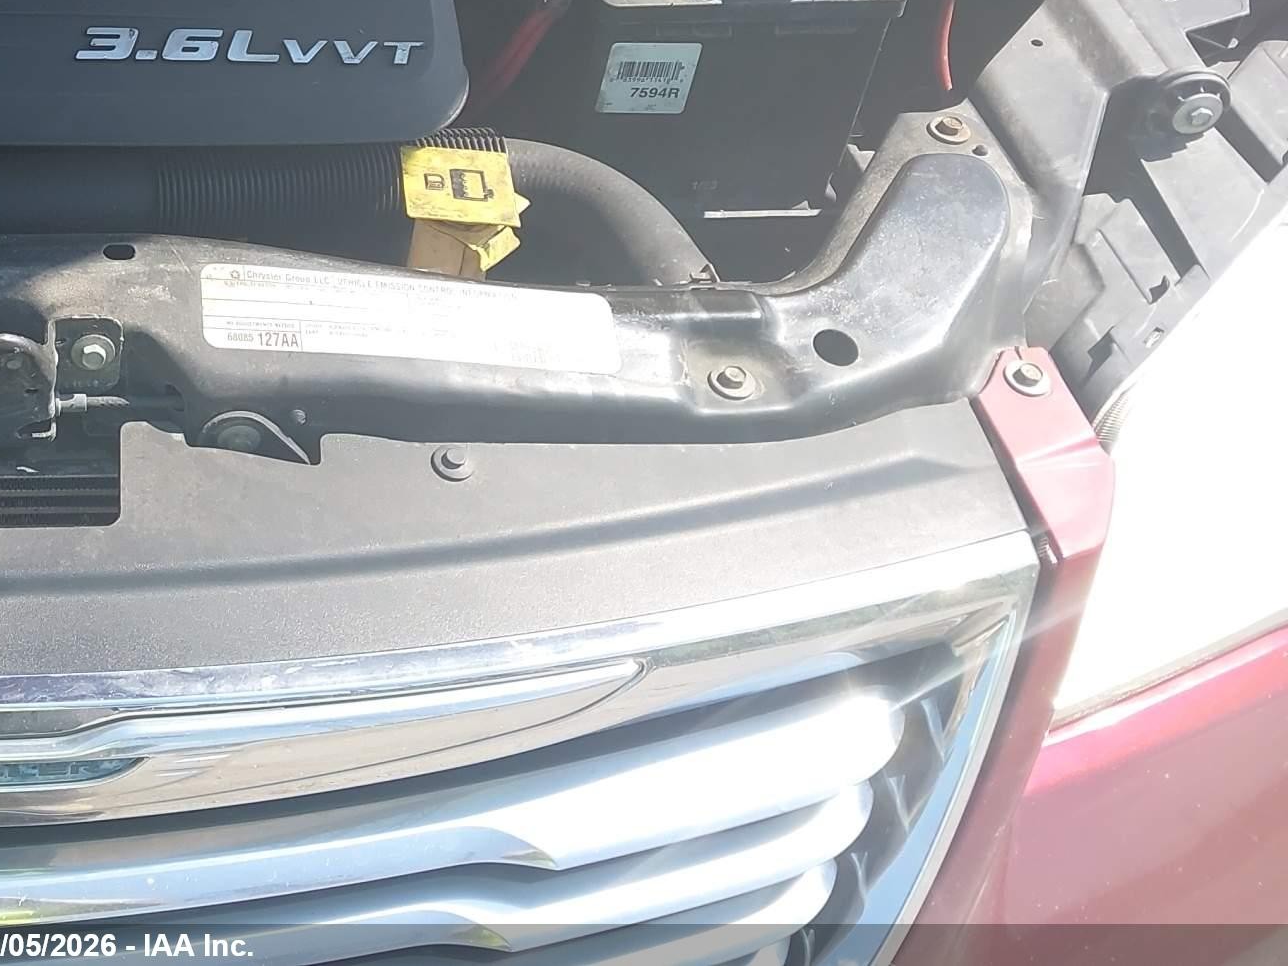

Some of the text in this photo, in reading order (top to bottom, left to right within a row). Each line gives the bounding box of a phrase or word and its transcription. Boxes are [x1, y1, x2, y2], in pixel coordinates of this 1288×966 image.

[629, 87, 681, 99] 7594R
[246, 269, 283, 283] Chrysler
[256, 331, 300, 349] 127AA
